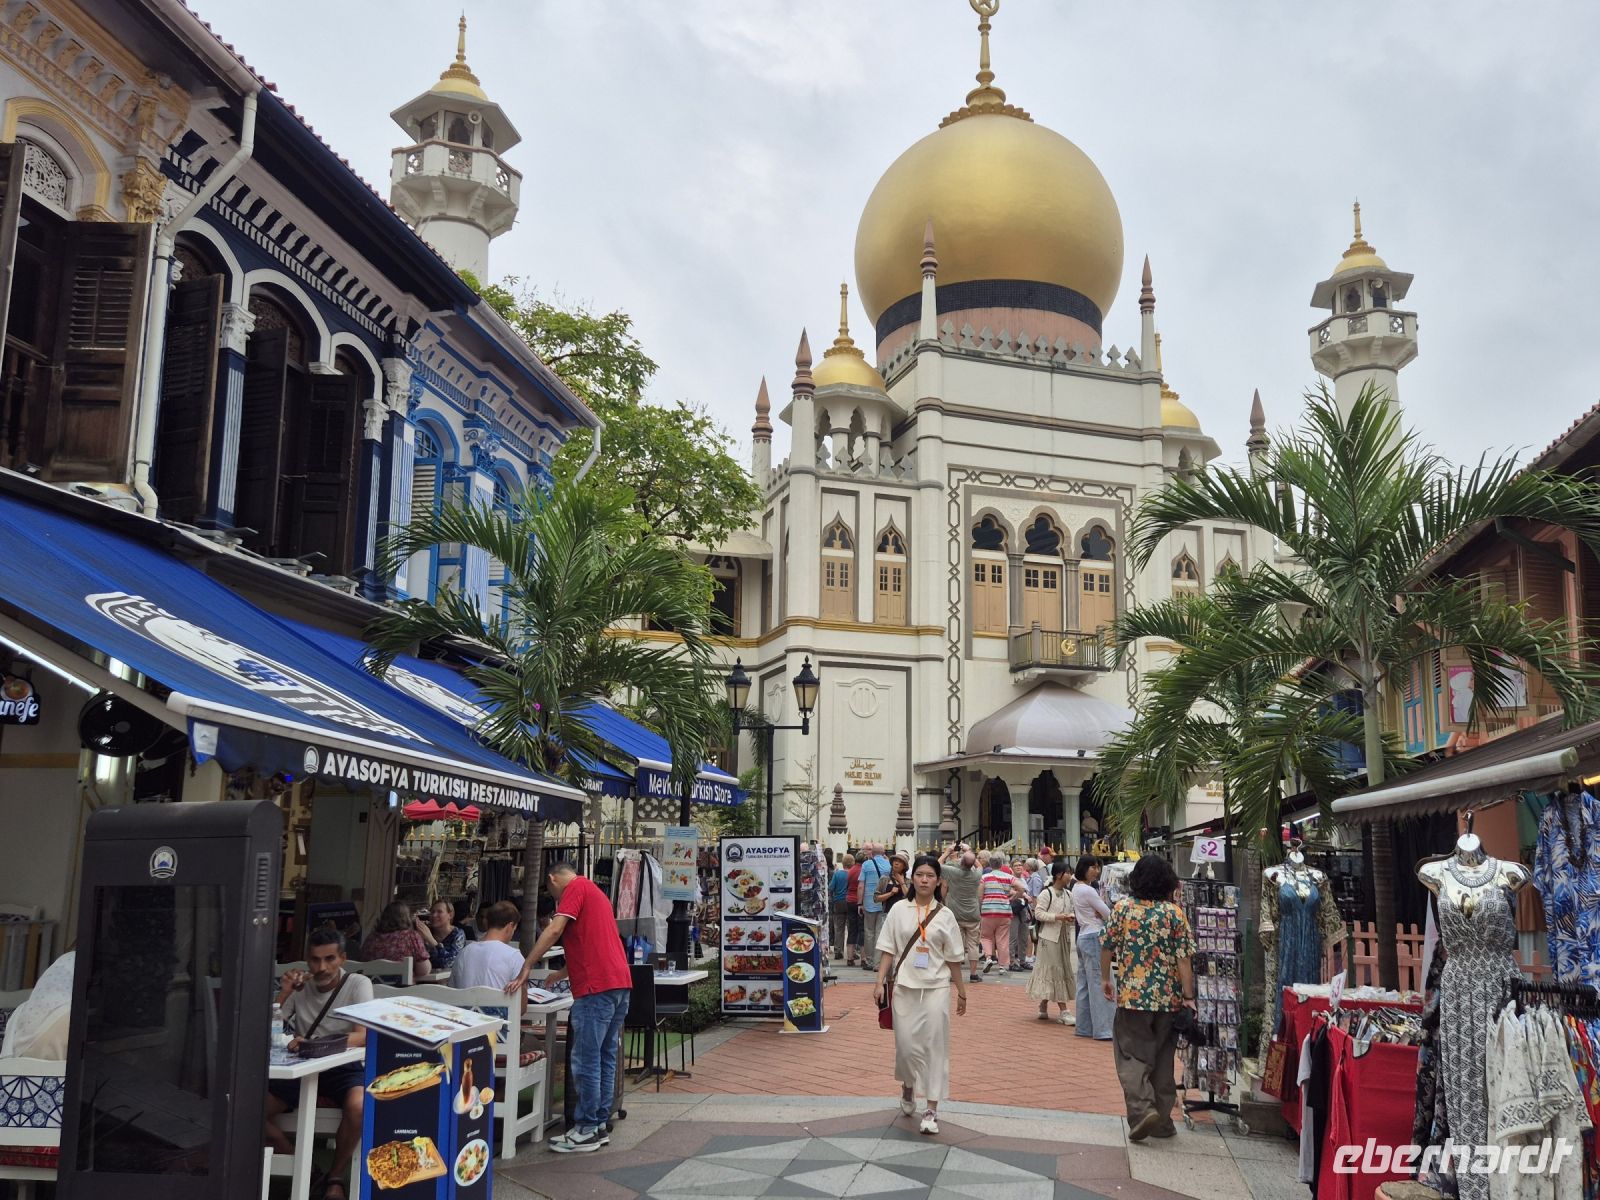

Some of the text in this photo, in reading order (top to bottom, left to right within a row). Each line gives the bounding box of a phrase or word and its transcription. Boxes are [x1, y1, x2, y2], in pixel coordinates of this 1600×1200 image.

[324, 752, 540, 813] AYASOFYA TURKISH RESTAURANT
[691, 779, 713, 801] urkish
[714, 784, 732, 805] Store
